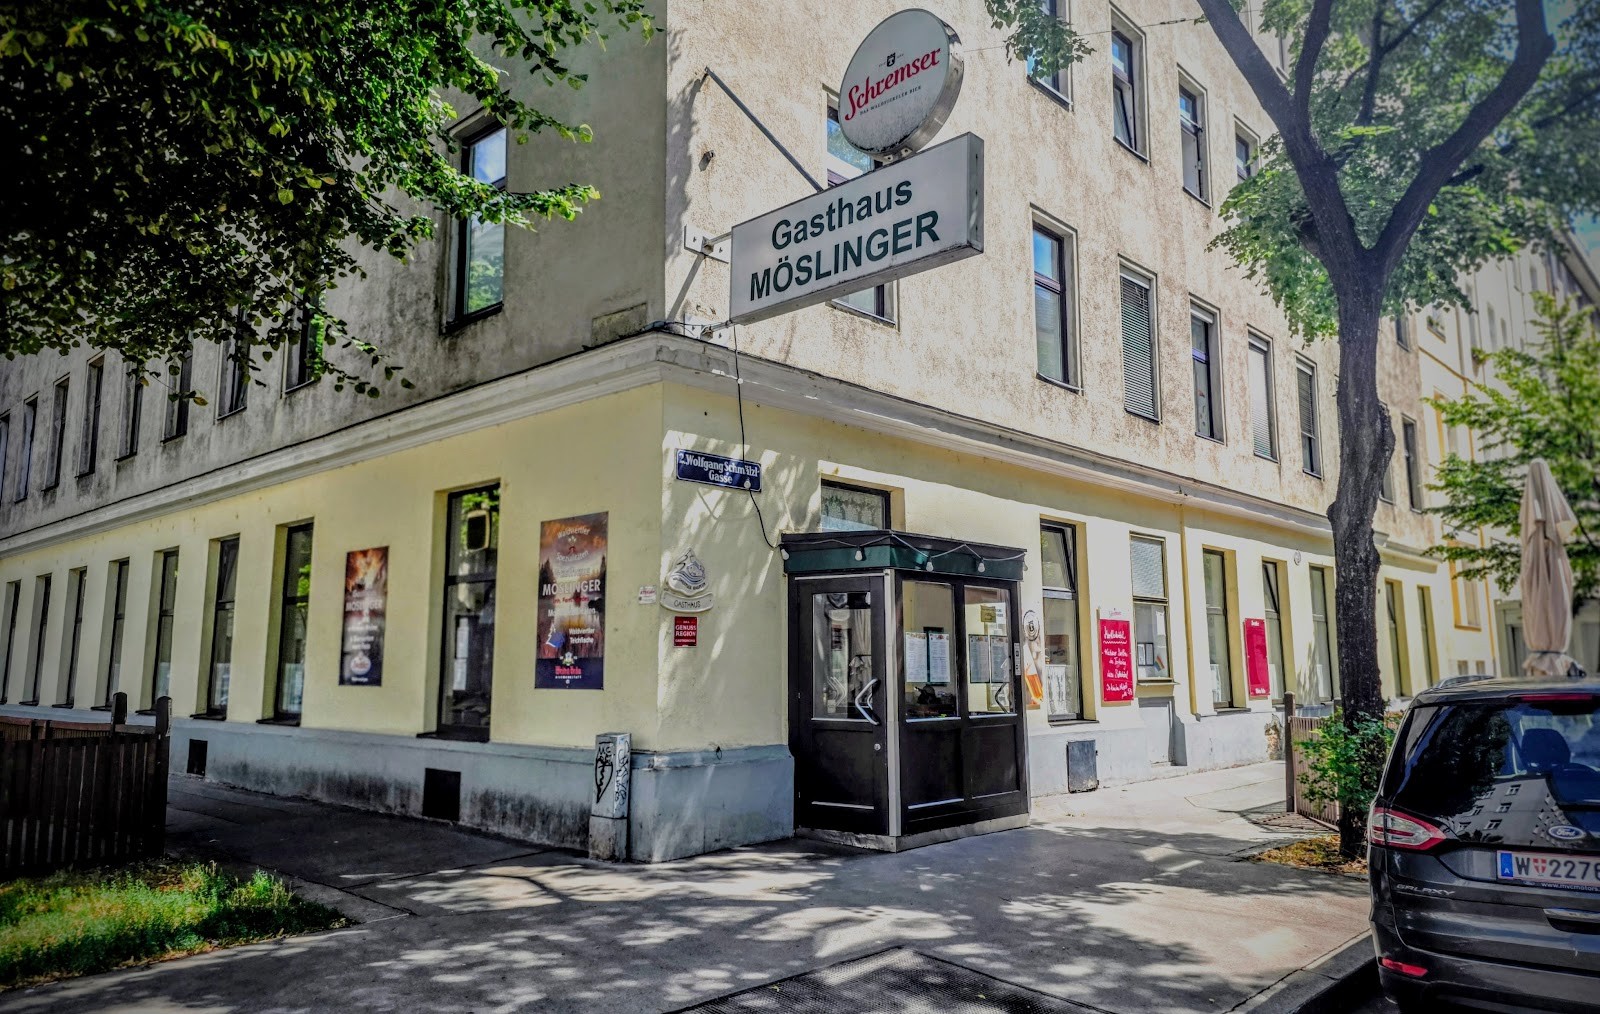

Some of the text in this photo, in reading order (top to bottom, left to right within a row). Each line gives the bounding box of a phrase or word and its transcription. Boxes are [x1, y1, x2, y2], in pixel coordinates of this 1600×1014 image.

[845, 48, 941, 120] Schremser
[772, 180, 912, 250] Gasthaus
[750, 210, 940, 301] MÖSLINGER
[708, 470, 733, 484] Gasse
[673, 600, 701, 609] GASTHAUS
[1556, 828, 1575, 837] Ford
[1515, 856, 1530, 876] W
[1396, 883, 1456, 896] GALAXY
